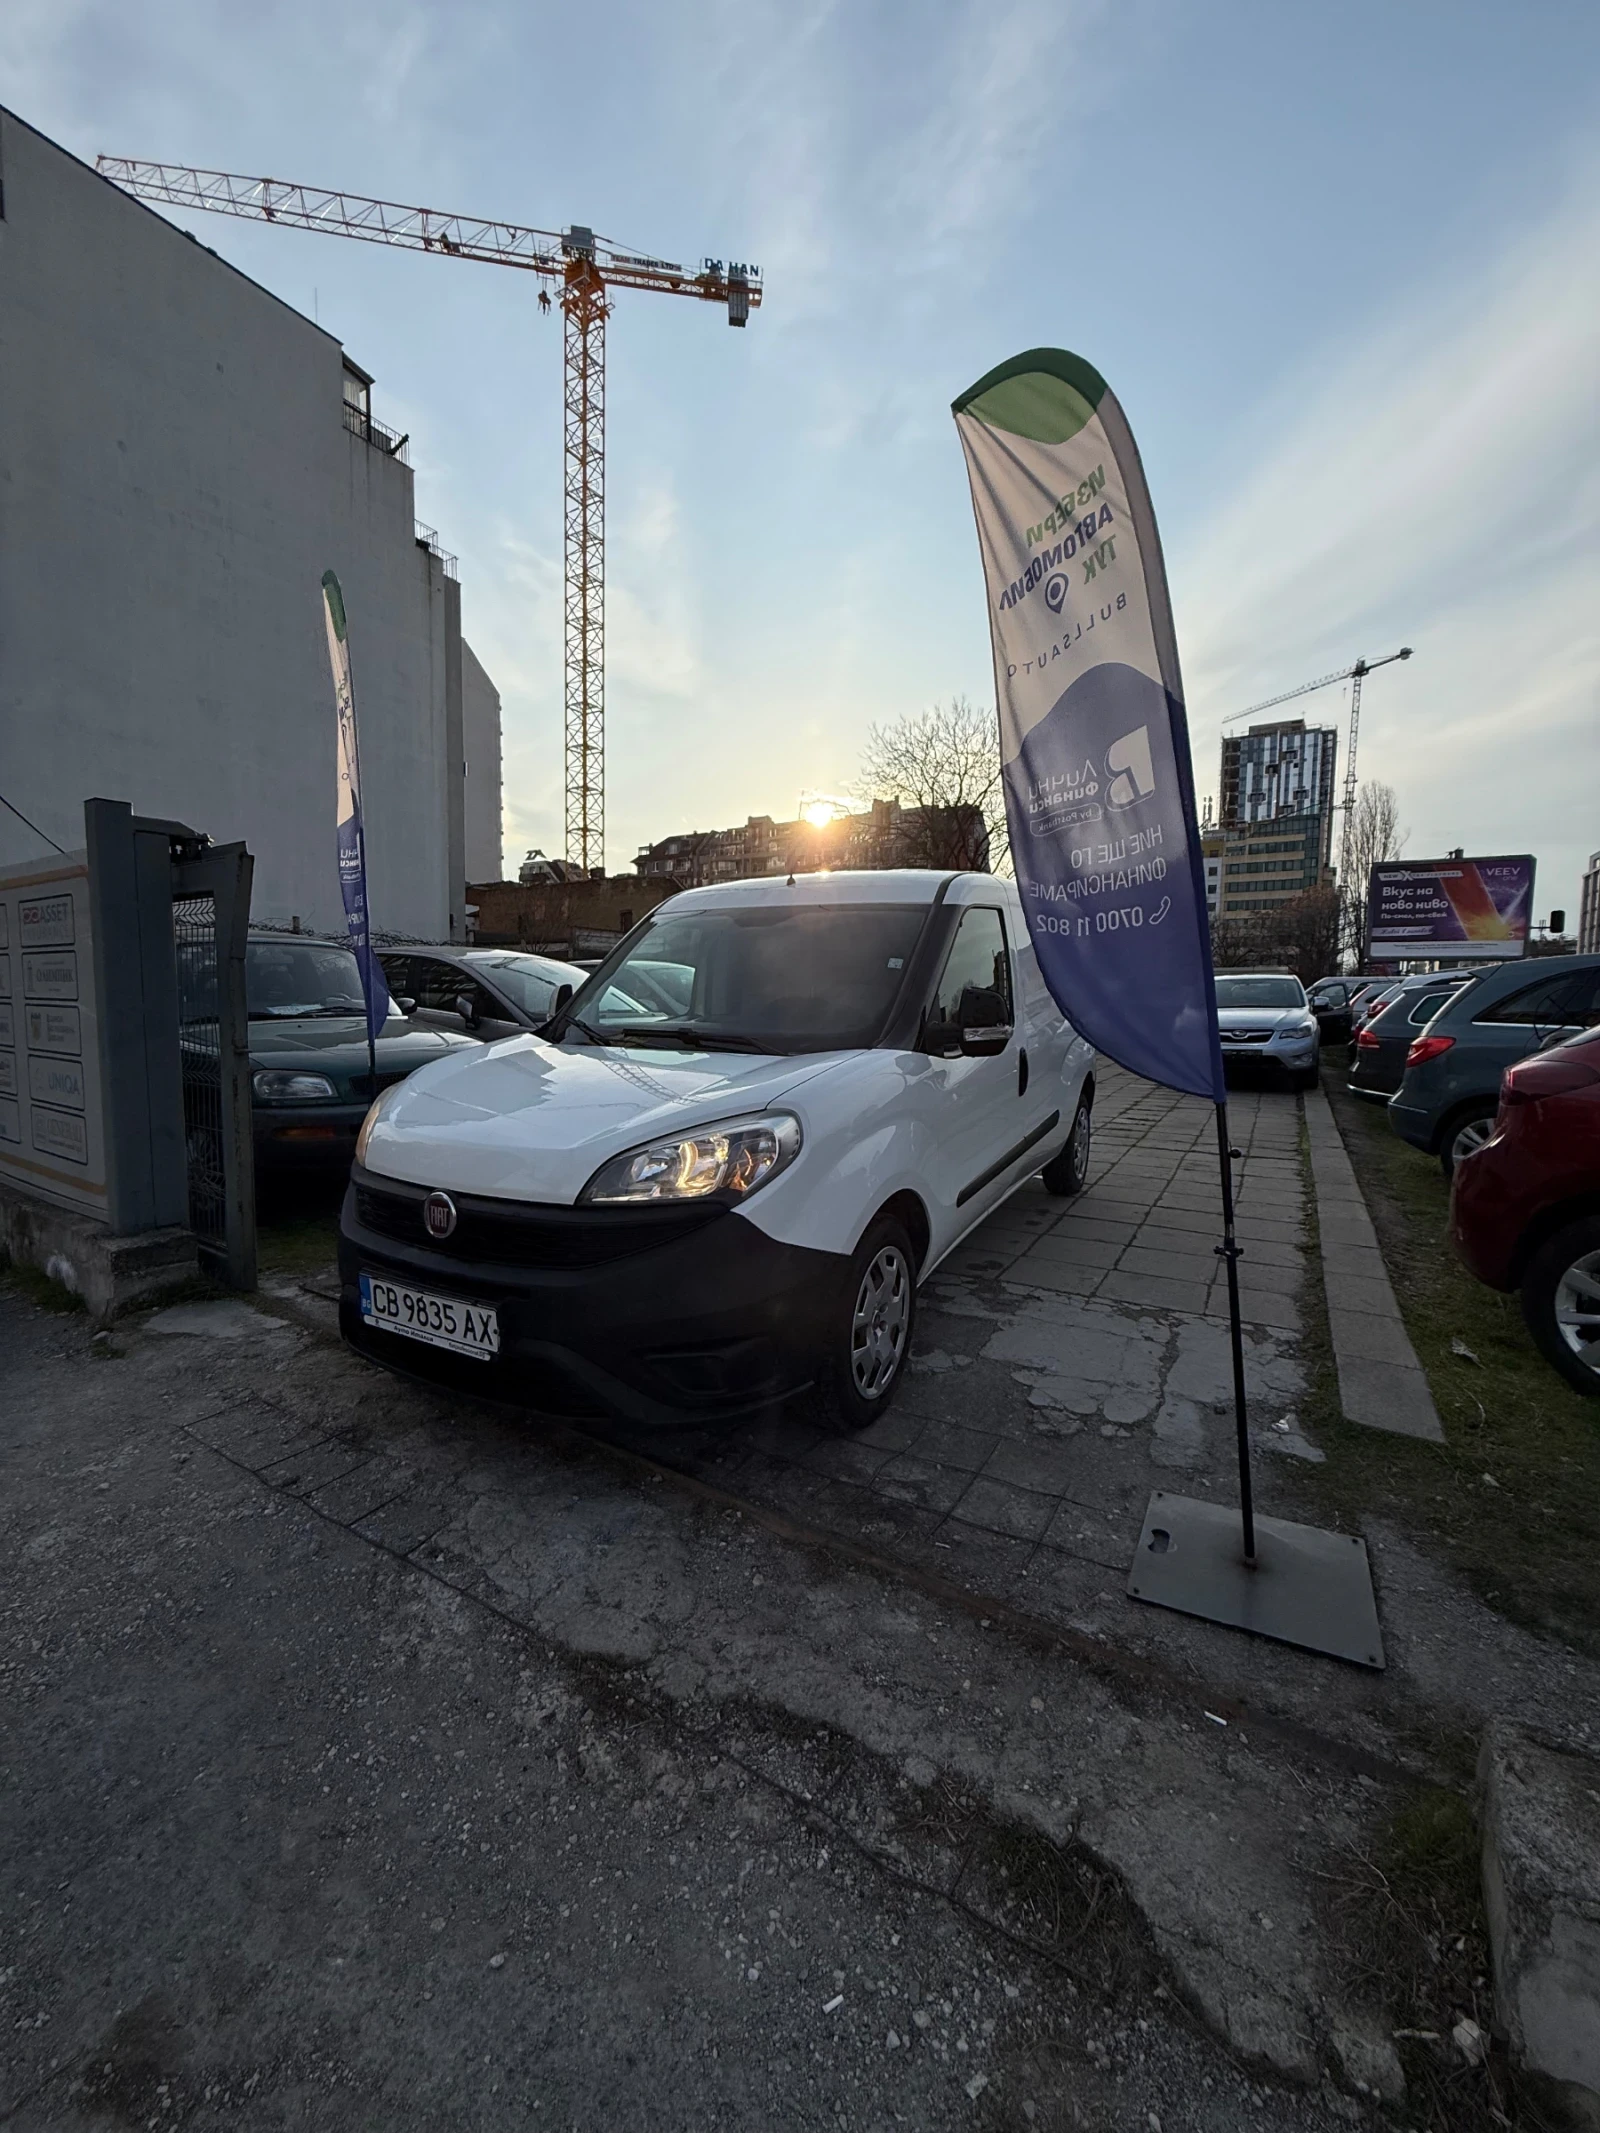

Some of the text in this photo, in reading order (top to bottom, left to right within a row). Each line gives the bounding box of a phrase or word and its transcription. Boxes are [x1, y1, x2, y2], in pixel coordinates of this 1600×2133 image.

[661, 261, 674, 271] LTD
[704, 258, 760, 277] DA HAN
[1486, 867, 1521, 876] VEEV
[1382, 886, 1414, 899] Вкус
[1381, 899, 1449, 910] ново ниво
[40, 903, 68, 923] ASSET
[48, 1072, 81, 1096] UNIQA
[430, 1205, 449, 1228] FIAT
[362, 1300, 371, 1309] BG
[373, 1284, 494, 1346] CB 9835 AX
